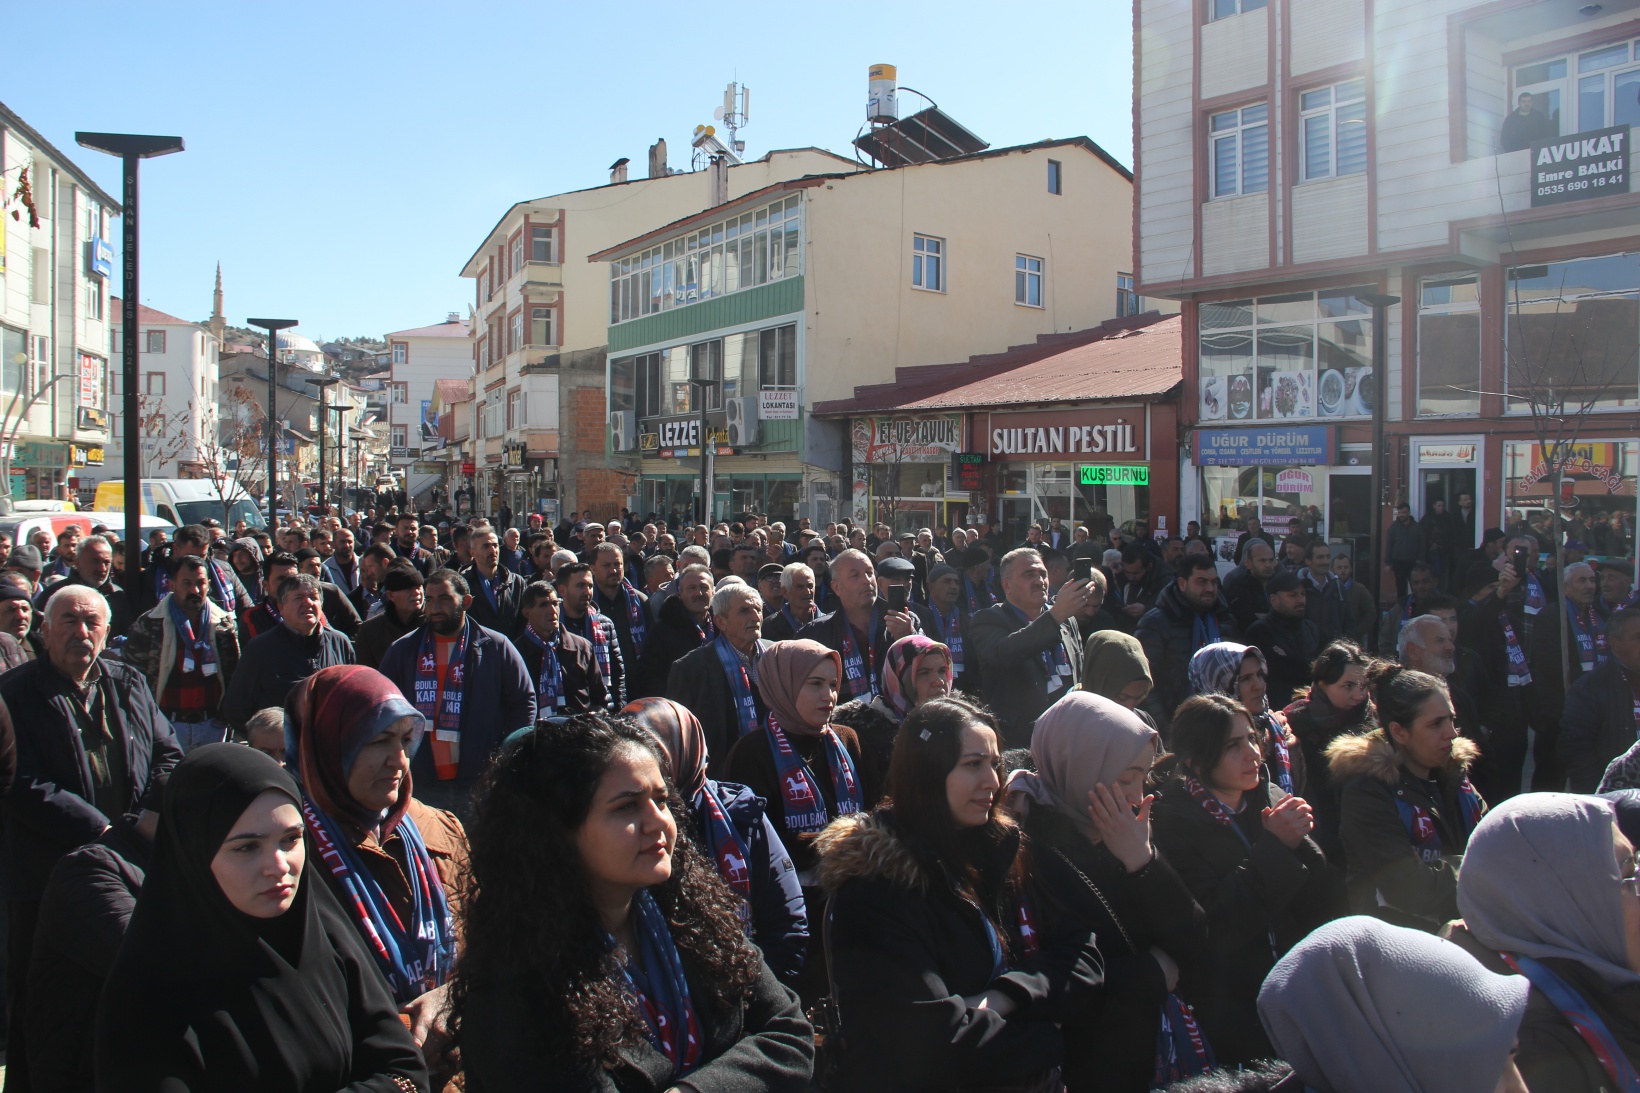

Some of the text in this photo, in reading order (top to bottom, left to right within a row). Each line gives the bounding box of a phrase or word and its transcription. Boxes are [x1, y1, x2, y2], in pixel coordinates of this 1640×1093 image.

[1537, 133, 1623, 166] AVUKAT
[1538, 155, 1623, 183] Emre BALKİ
[1537, 174, 1623, 196] 0535 690 18 41
[126, 338, 134, 374] 2021
[764, 392, 793, 400] LEZZET
[880, 419, 955, 444] ET VE TAVUK
[992, 418, 1137, 454] SULTAN PESTİL
[1211, 432, 1309, 447] UĞUR DÜRÜM
[1081, 467, 1148, 484] KUŞBURNU
[1280, 469, 1309, 482] UĞUR
[1580, 459, 1623, 494] OCAĞI
[1276, 483, 1313, 492] DÜRÜM
[416, 691, 436, 702] KAR
